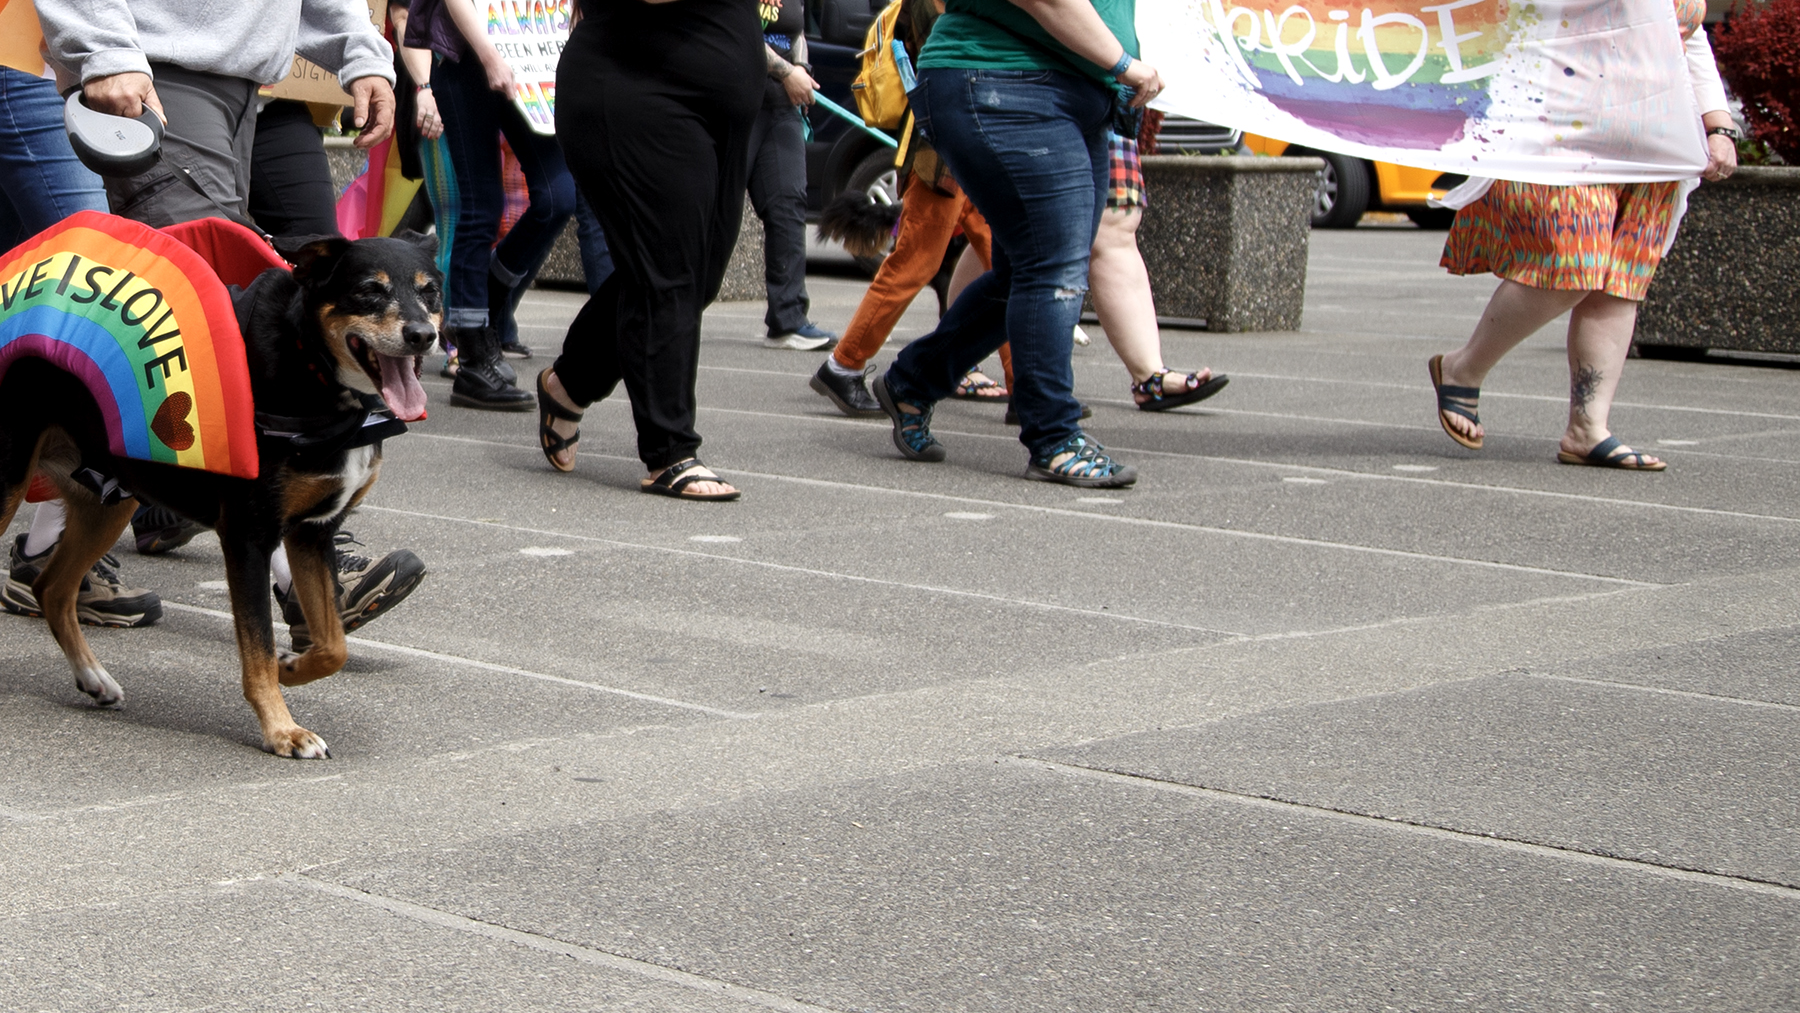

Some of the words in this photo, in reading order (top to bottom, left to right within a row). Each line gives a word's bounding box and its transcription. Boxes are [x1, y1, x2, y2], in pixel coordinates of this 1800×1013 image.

[494, 43, 533, 59] BEEN
[55, 254, 114, 304] IS
[100, 271, 188, 390] LOVE
